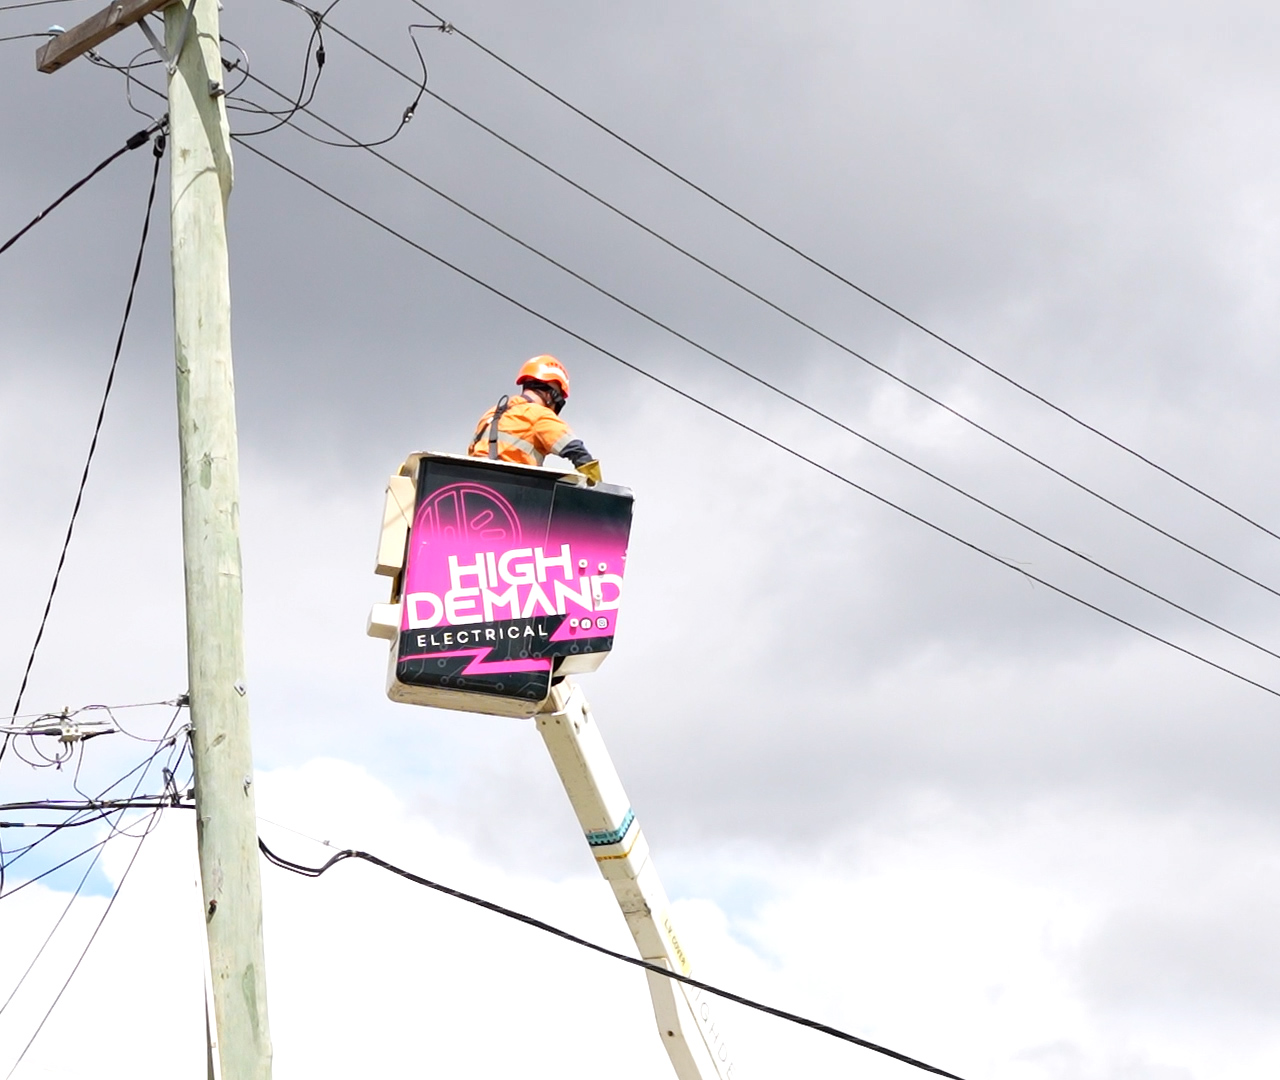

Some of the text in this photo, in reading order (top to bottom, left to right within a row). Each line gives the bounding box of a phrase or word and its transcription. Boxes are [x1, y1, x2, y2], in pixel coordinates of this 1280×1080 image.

[448, 544, 573, 591] HIGH
[406, 573, 624, 630] DEMAND
[417, 624, 548, 647] ELECTRICAL
